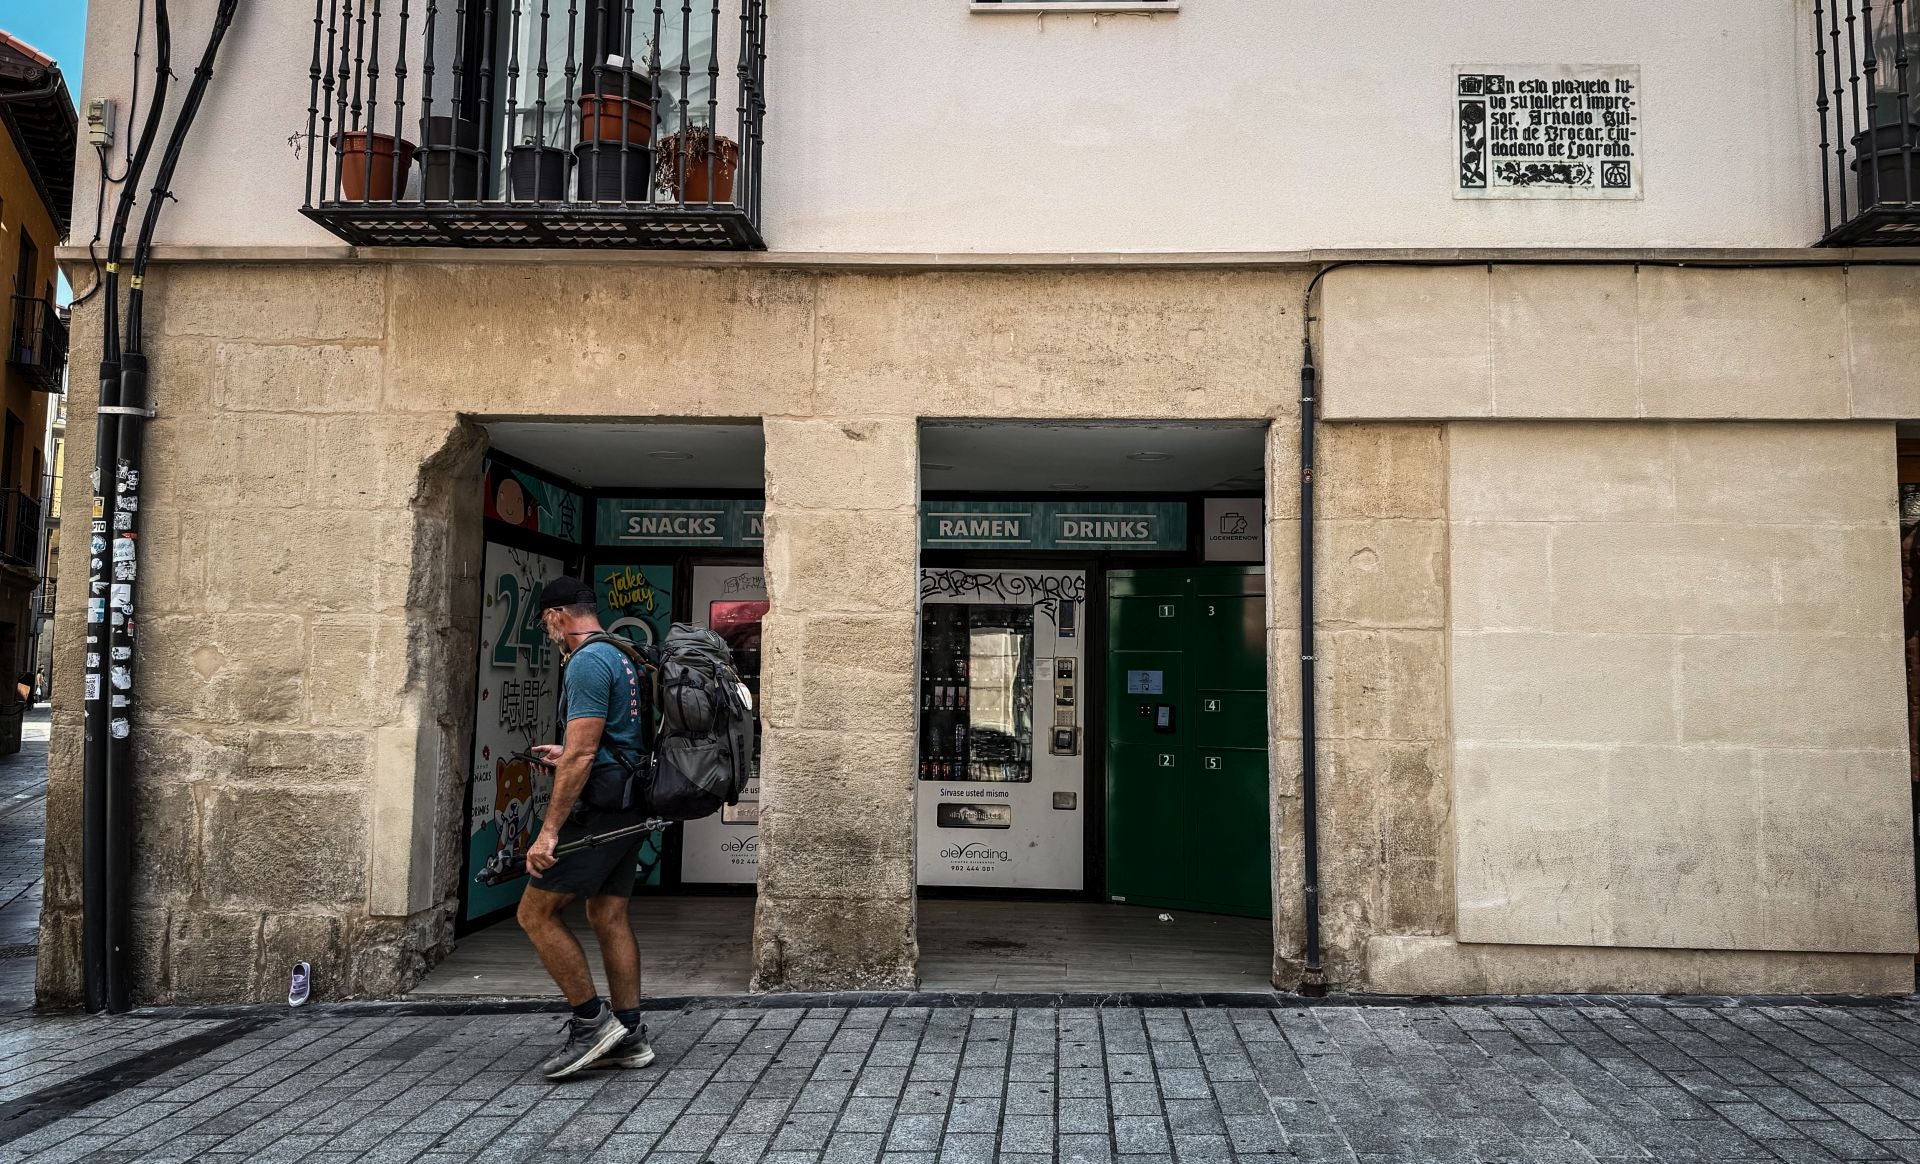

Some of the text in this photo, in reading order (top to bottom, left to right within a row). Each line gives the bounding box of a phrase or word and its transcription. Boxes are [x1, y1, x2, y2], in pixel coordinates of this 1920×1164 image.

[1519, 79, 1548, 94] esta
[1552, 79, 1610, 95] plazuela
[1511, 95, 1528, 110] su
[1530, 94, 1567, 110] taller
[1570, 94, 1583, 110] el
[1586, 93, 1636, 111] impre-
[1528, 109, 1593, 126] Arnaldo
[1602, 109, 1637, 127] Gui-
[1490, 125, 1518, 141] llen
[1523, 126, 1540, 141] de
[1491, 140, 1635, 159] dadano de Logroño.
[627, 516, 716, 534] SNACKS
[939, 519, 1020, 537] RAMEN
[1062, 520, 1150, 538] DRINKS
[603, 565, 645, 592] Take
[607, 586, 655, 611] Away
[1208, 606, 1216, 616] 3
[493, 573, 543, 670] 24
[621, 657, 638, 717] ESCAPE
[500, 680, 541, 728] 時間
[1208, 700, 1216, 711] 4
[1162, 755, 1170, 766] 2
[1209, 758, 1217, 768] 5
[940, 787, 1009, 798] Sírvase usted mismo
